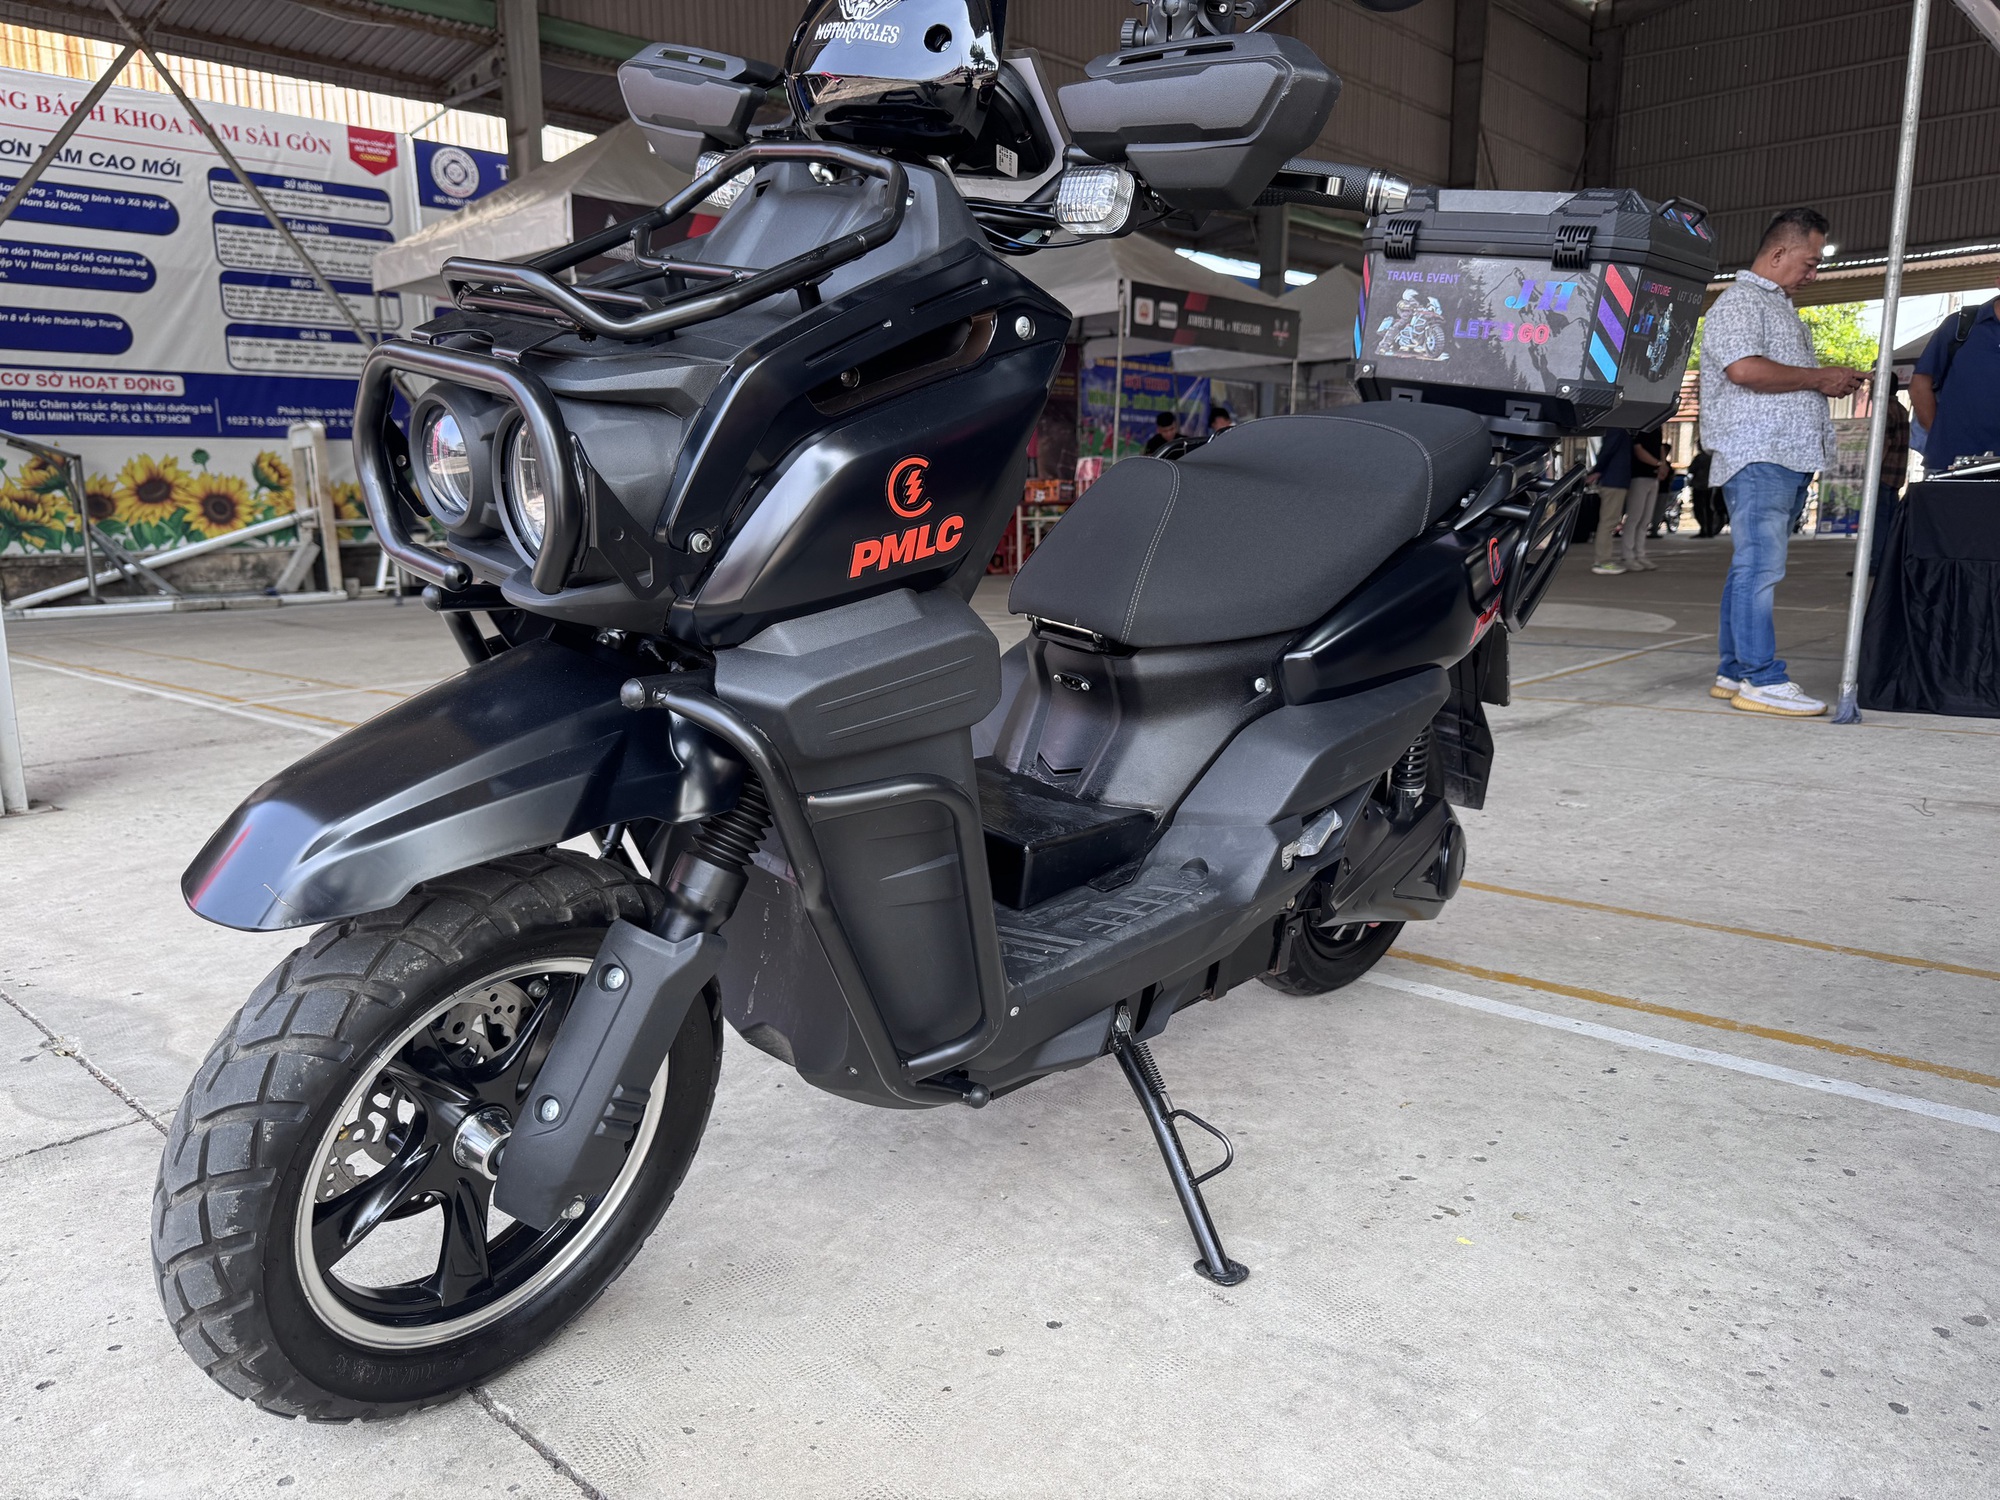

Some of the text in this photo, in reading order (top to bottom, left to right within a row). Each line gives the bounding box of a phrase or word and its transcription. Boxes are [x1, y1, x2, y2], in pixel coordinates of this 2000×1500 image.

[814, 21, 900, 44] MOTORCYCLES
[113, 106, 183, 134] KHOA
[189, 118, 240, 142] NM
[245, 124, 280, 147] SÀI
[286, 130, 332, 154] GÒN
[89, 152, 136, 171] CAO
[141, 157, 181, 177] MỚI
[20, 198, 42, 207] Nam
[44, 199, 59, 209] Sài
[113, 195, 125, 205] và
[31, 261, 53, 271] Nam
[55, 262, 69, 271] Sài
[113, 256, 134, 266] Minh
[1386, 270, 1461, 284] TRAVEL EVENT
[98, 318, 124, 331] Trung
[1517, 323, 1552, 345] GO
[0, 372, 30, 386] CƠ
[36, 371, 64, 388] SỞ
[69, 375, 119, 392] HOẠT
[849, 515, 964, 579] PMLC
